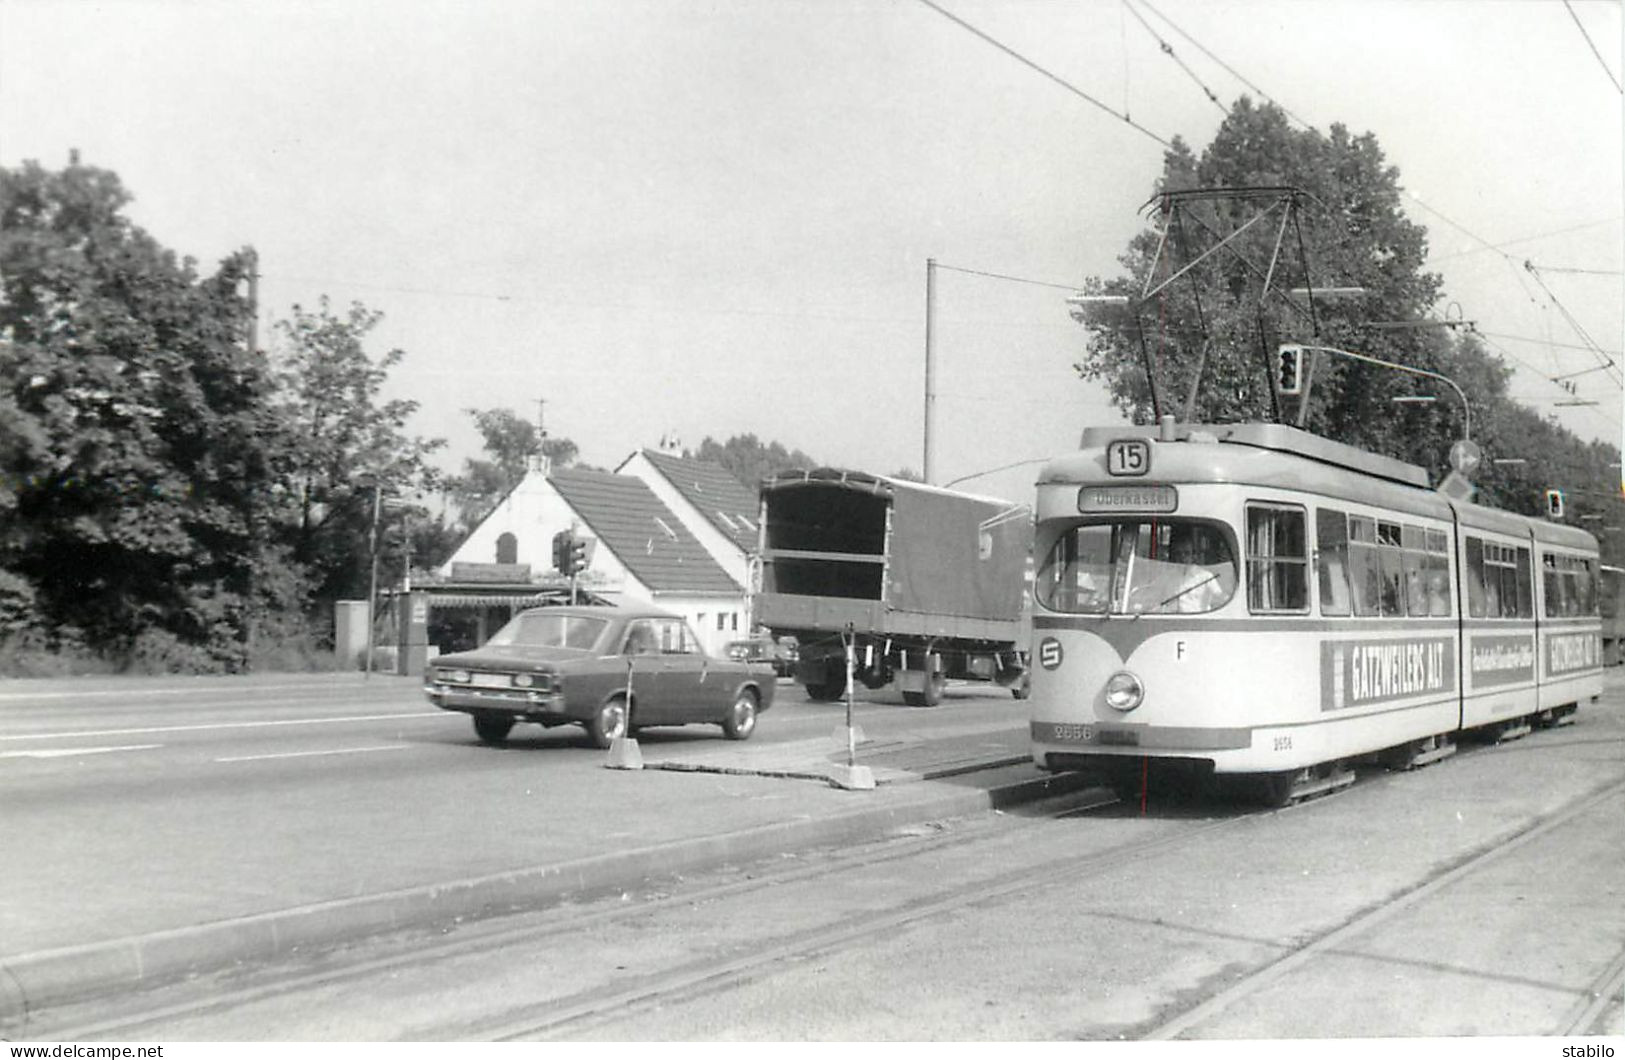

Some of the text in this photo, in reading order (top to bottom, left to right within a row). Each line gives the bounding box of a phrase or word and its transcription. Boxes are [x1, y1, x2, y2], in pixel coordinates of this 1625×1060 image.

[1118, 445, 1142, 469] 15
[1176, 641, 1186, 660] F
[1352, 643, 1424, 701] GATZWEILERS
[1427, 641, 1443, 689] ALT
